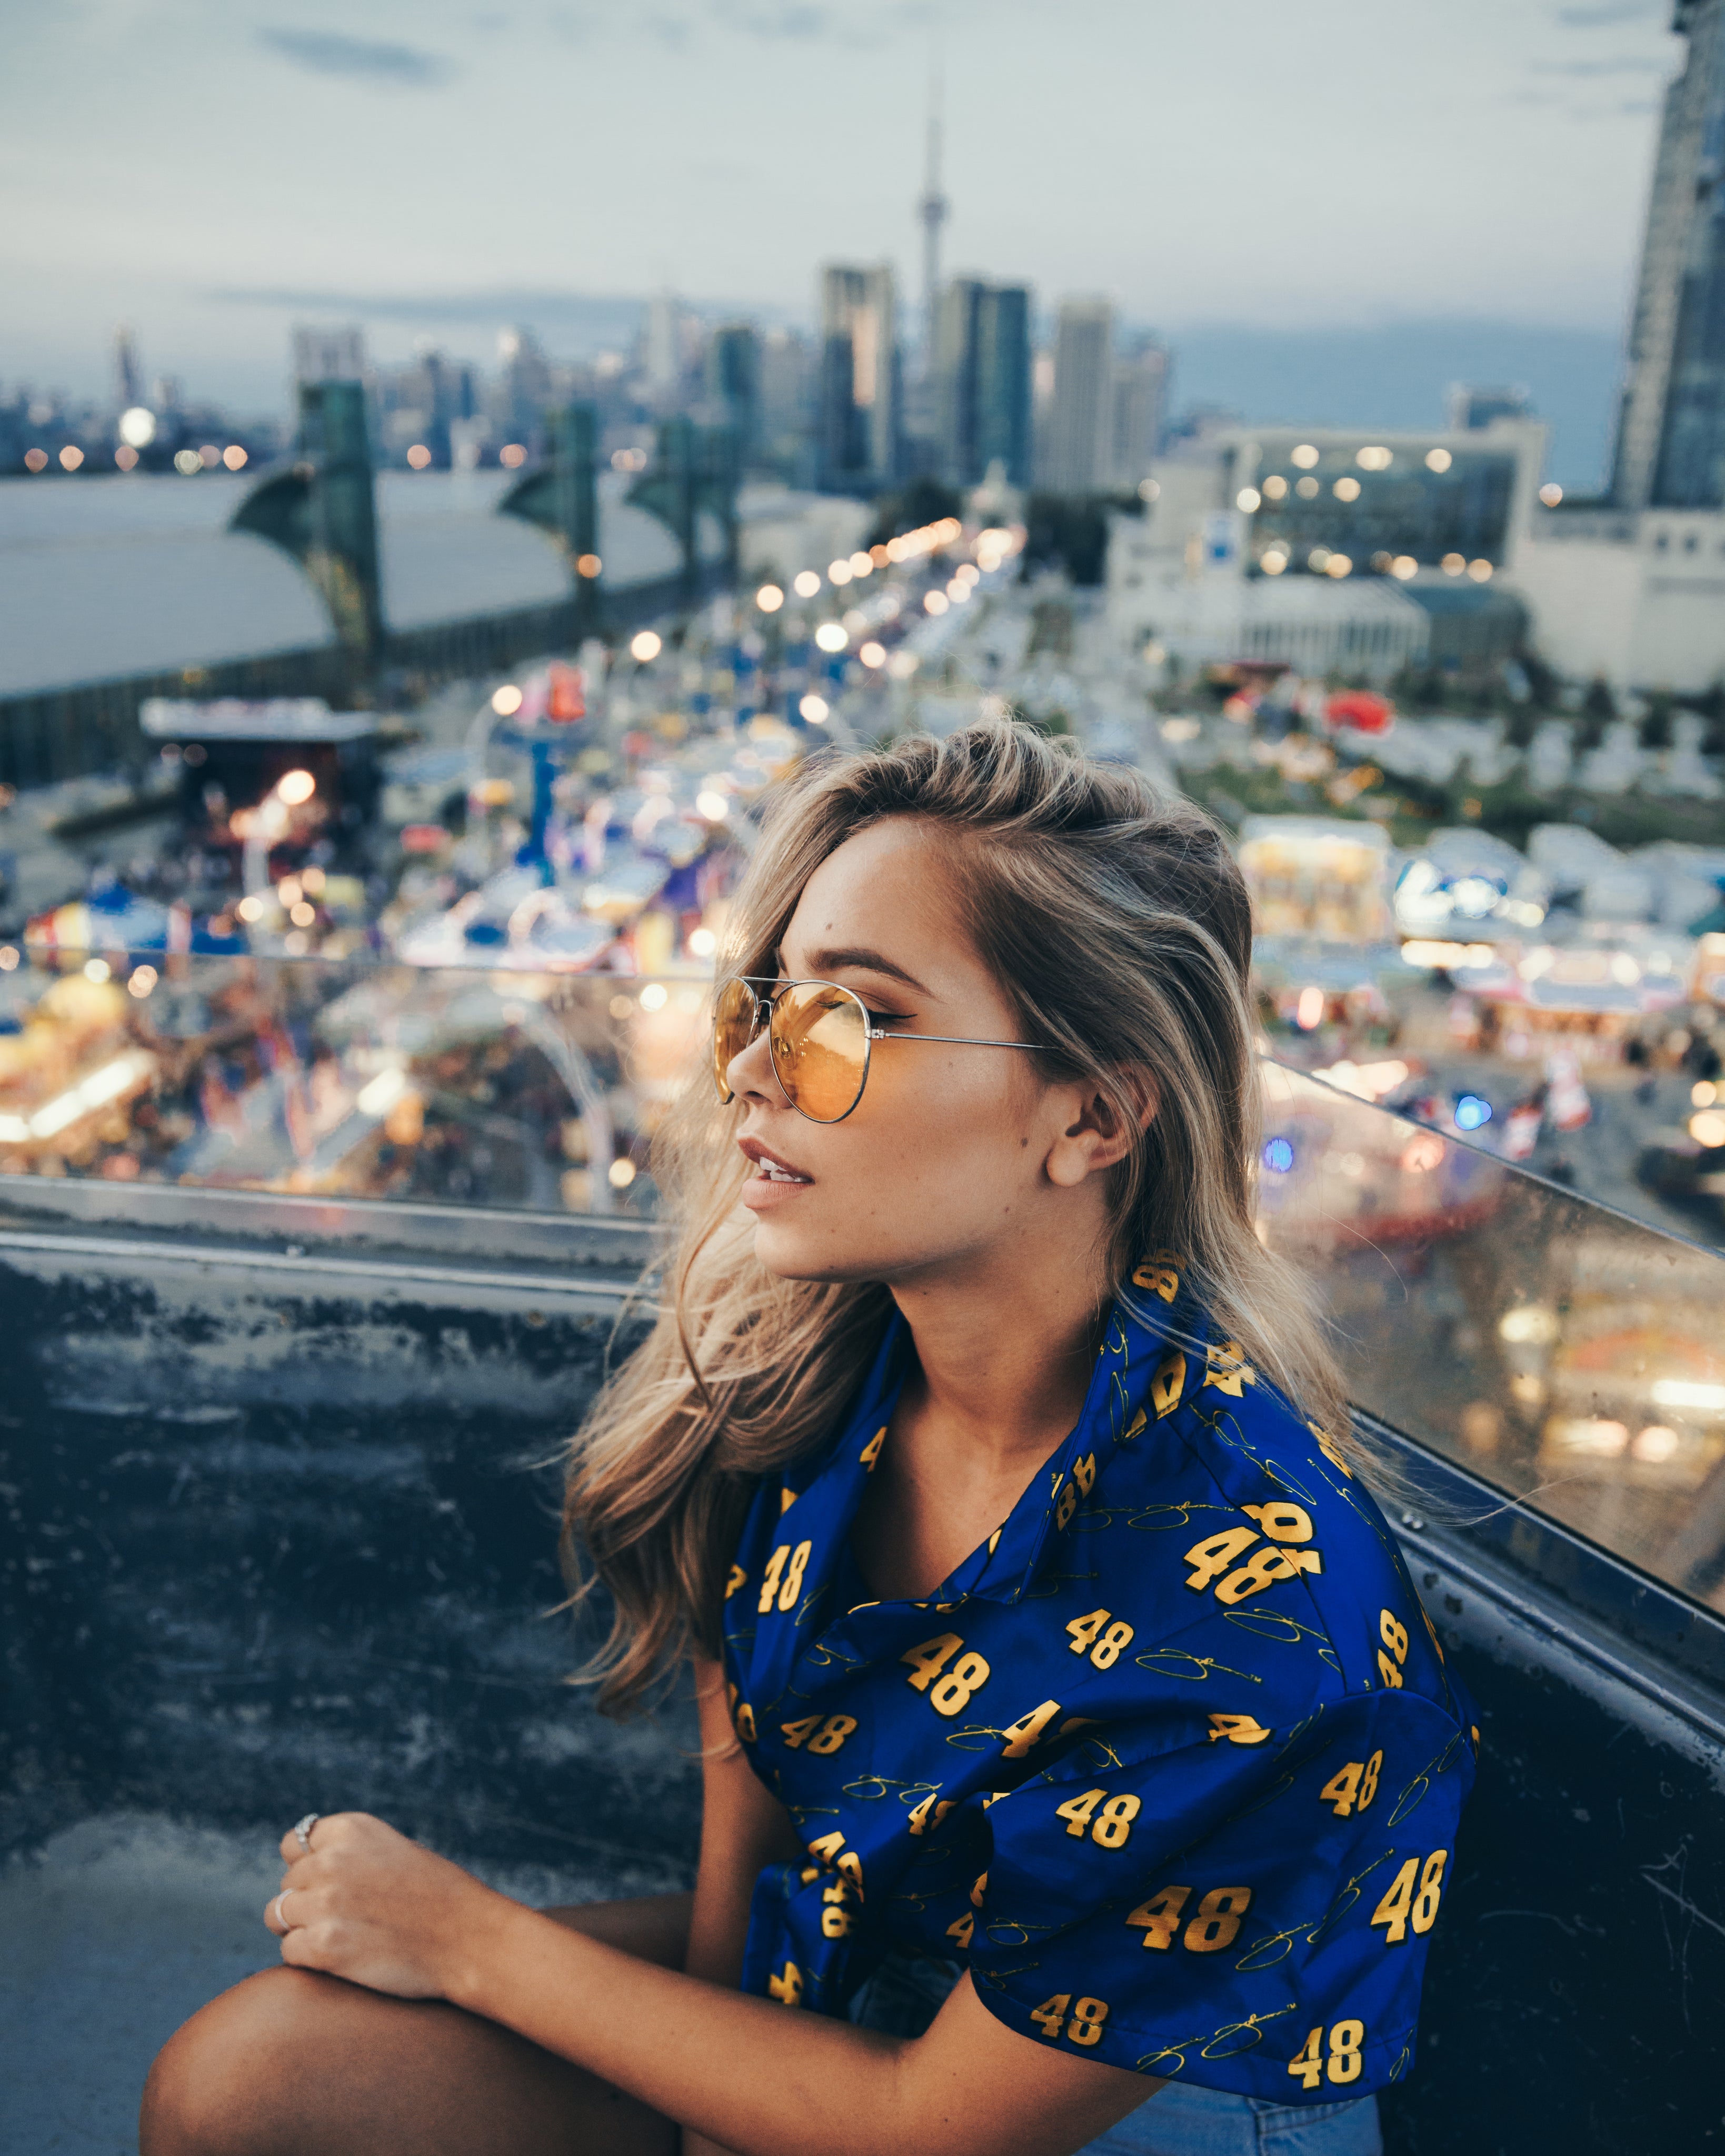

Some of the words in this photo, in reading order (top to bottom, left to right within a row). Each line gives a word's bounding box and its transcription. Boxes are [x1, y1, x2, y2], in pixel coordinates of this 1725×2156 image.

[757, 1540, 812, 1613] 48
[1183, 1526, 1302, 1605] 48
[1065, 1608, 1134, 1670] 48
[900, 1633, 990, 1716] 48
[781, 1714, 857, 1754] 48
[1320, 1750, 1383, 1816] 48
[1055, 1789, 1141, 1848] 48
[1125, 1886, 1251, 1952] 48
[1370, 1849, 1448, 1943] 48
[1030, 1994, 1109, 2045] 48
[1288, 2019, 1364, 2089] 48
